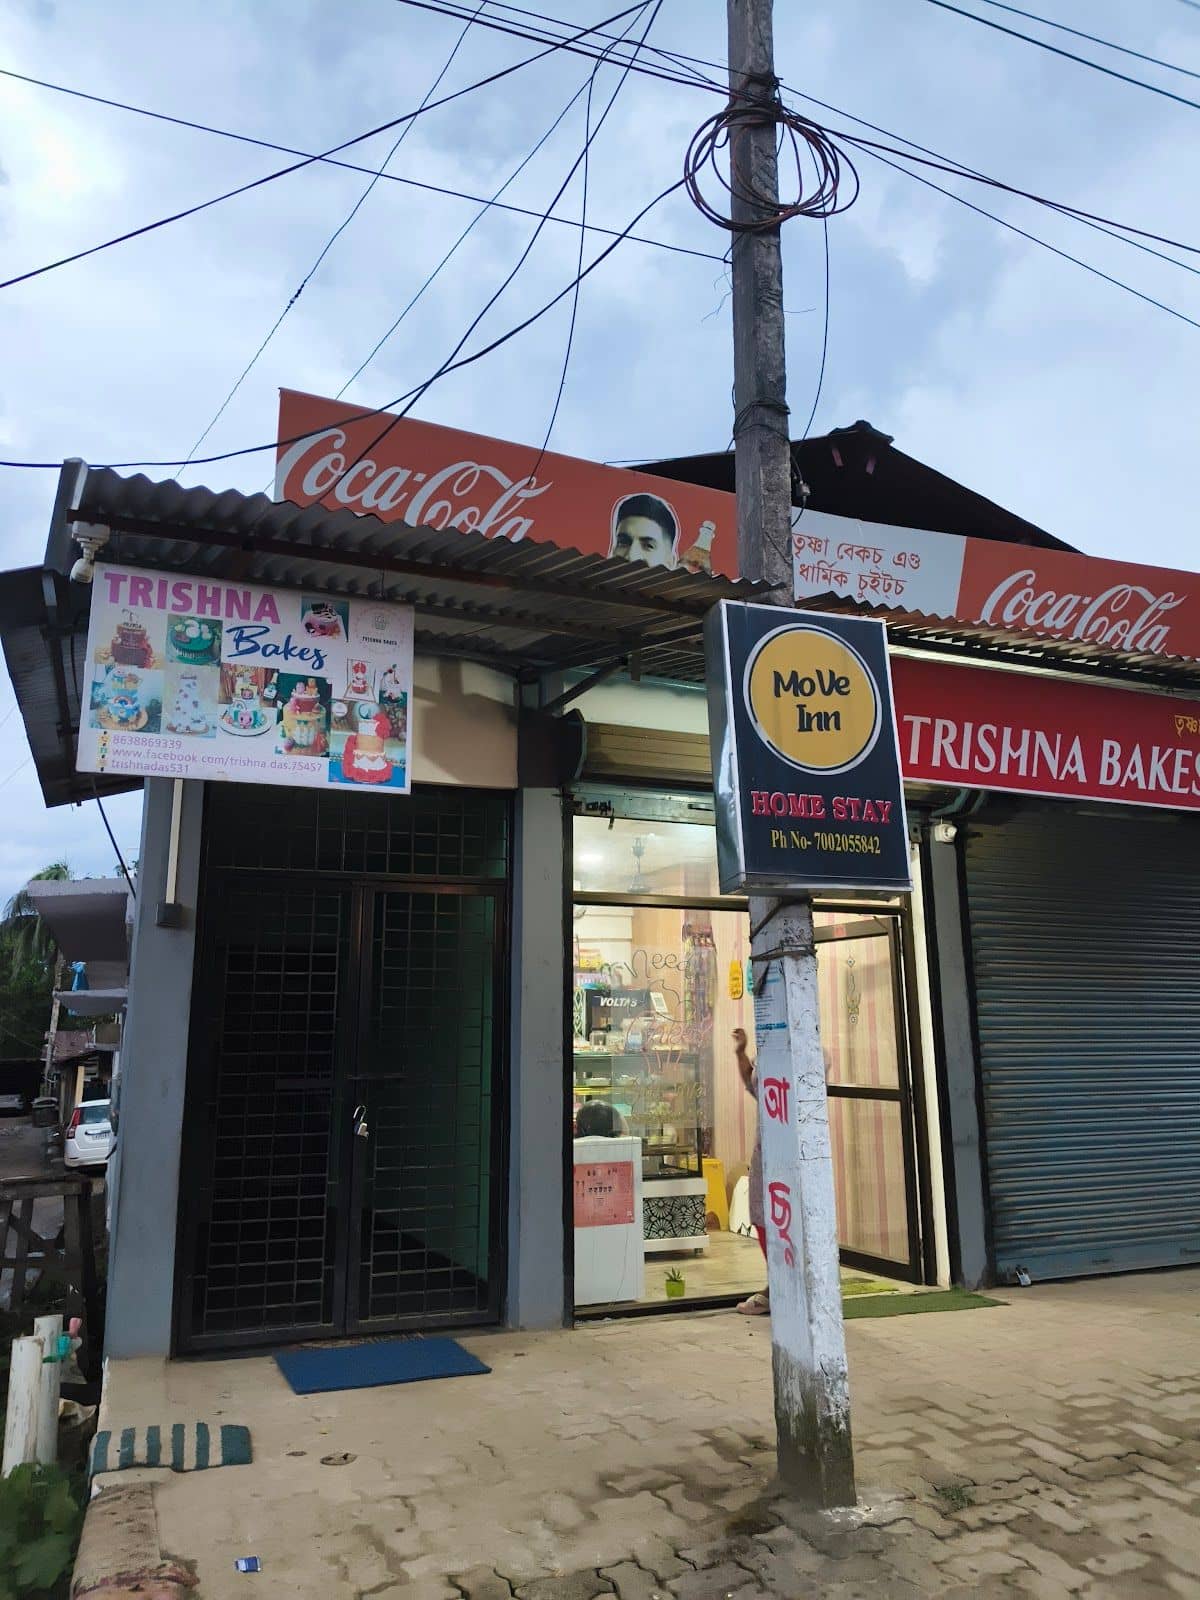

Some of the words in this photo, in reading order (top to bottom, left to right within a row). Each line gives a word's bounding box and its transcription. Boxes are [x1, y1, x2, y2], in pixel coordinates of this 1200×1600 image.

[274, 428, 553, 543] Coca-Cola
[104, 571, 281, 626] TRISHNA
[975, 569, 1186, 653] Coca-Cola
[227, 625, 328, 671] Bakes
[796, 704, 841, 732] Inn
[903, 714, 1087, 784] TRISHNA
[751, 790, 827, 820] HOME
[833, 797, 893, 824] STAY
[771, 829, 788, 849] Ph
[791, 830, 812, 851] No-
[814, 832, 881, 855] 7002055842
